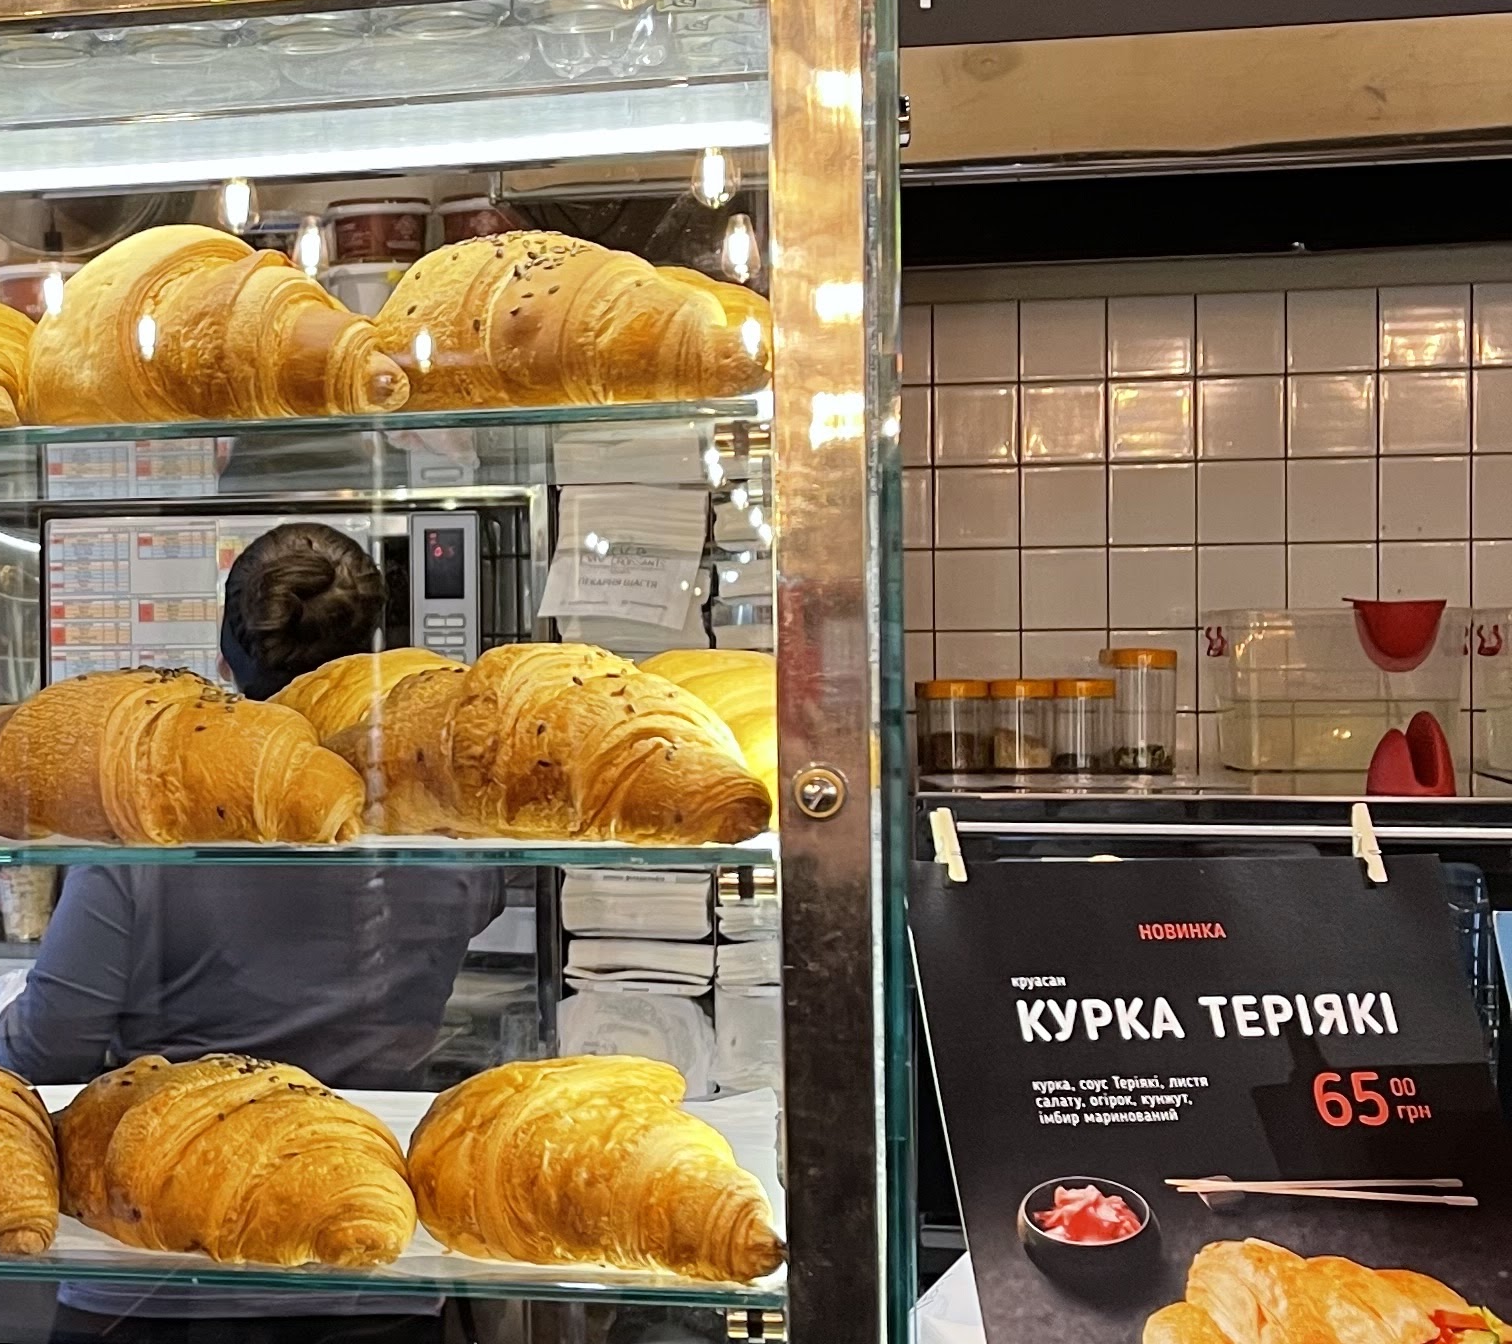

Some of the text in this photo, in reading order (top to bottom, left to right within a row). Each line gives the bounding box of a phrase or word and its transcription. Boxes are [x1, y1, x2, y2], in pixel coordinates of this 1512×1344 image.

[1138, 922, 1227, 941] НОВИНКА
[1010, 974, 1066, 990] круасан
[1016, 991, 1400, 1044] КУРКА ТЕРІЯКІ
[1031, 1074, 1209, 1094] курка, соус Теріякі, листя
[1035, 1093, 1193, 1110] салату, огірок, кунжут,
[1313, 1070, 1416, 1128] 65 00
[1038, 1107, 1179, 1126] імбир маринований
[1396, 1103, 1432, 1124] грн
